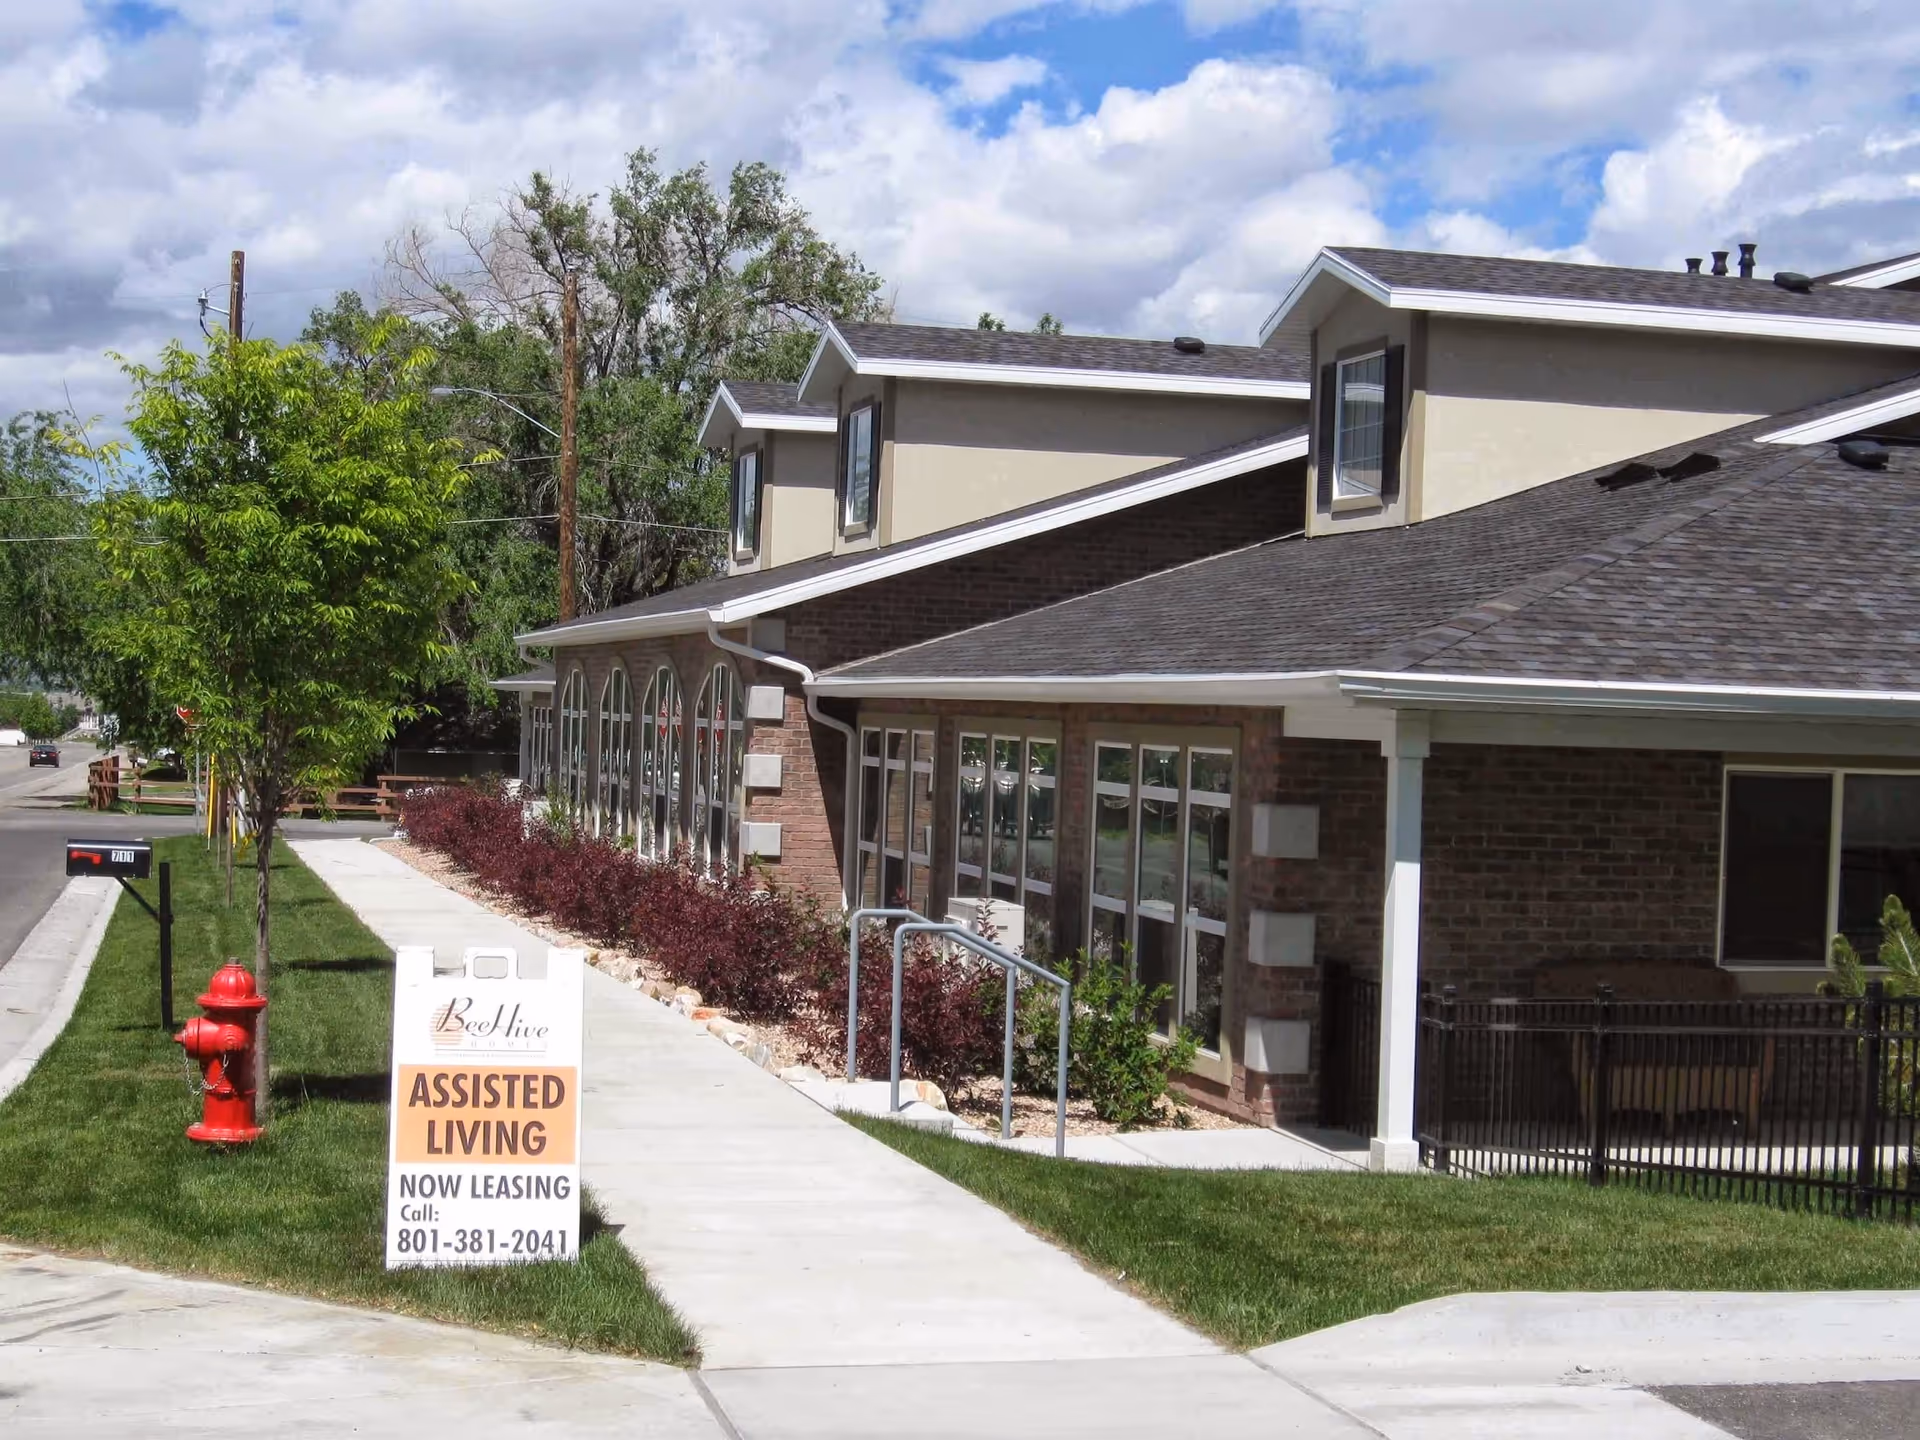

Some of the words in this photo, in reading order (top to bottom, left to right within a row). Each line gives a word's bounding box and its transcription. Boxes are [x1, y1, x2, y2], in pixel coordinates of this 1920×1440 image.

[112, 850, 134, 862] 711
[436, 997, 549, 1038] BeeHive
[408, 1072, 565, 1109] ASSISTED
[427, 1119, 547, 1156] LIVING
[400, 1174, 462, 1199] NOW
[472, 1175, 571, 1200] LEASING
[400, 1204, 439, 1222] Call:
[397, 1228, 567, 1254] 801-381-2041
